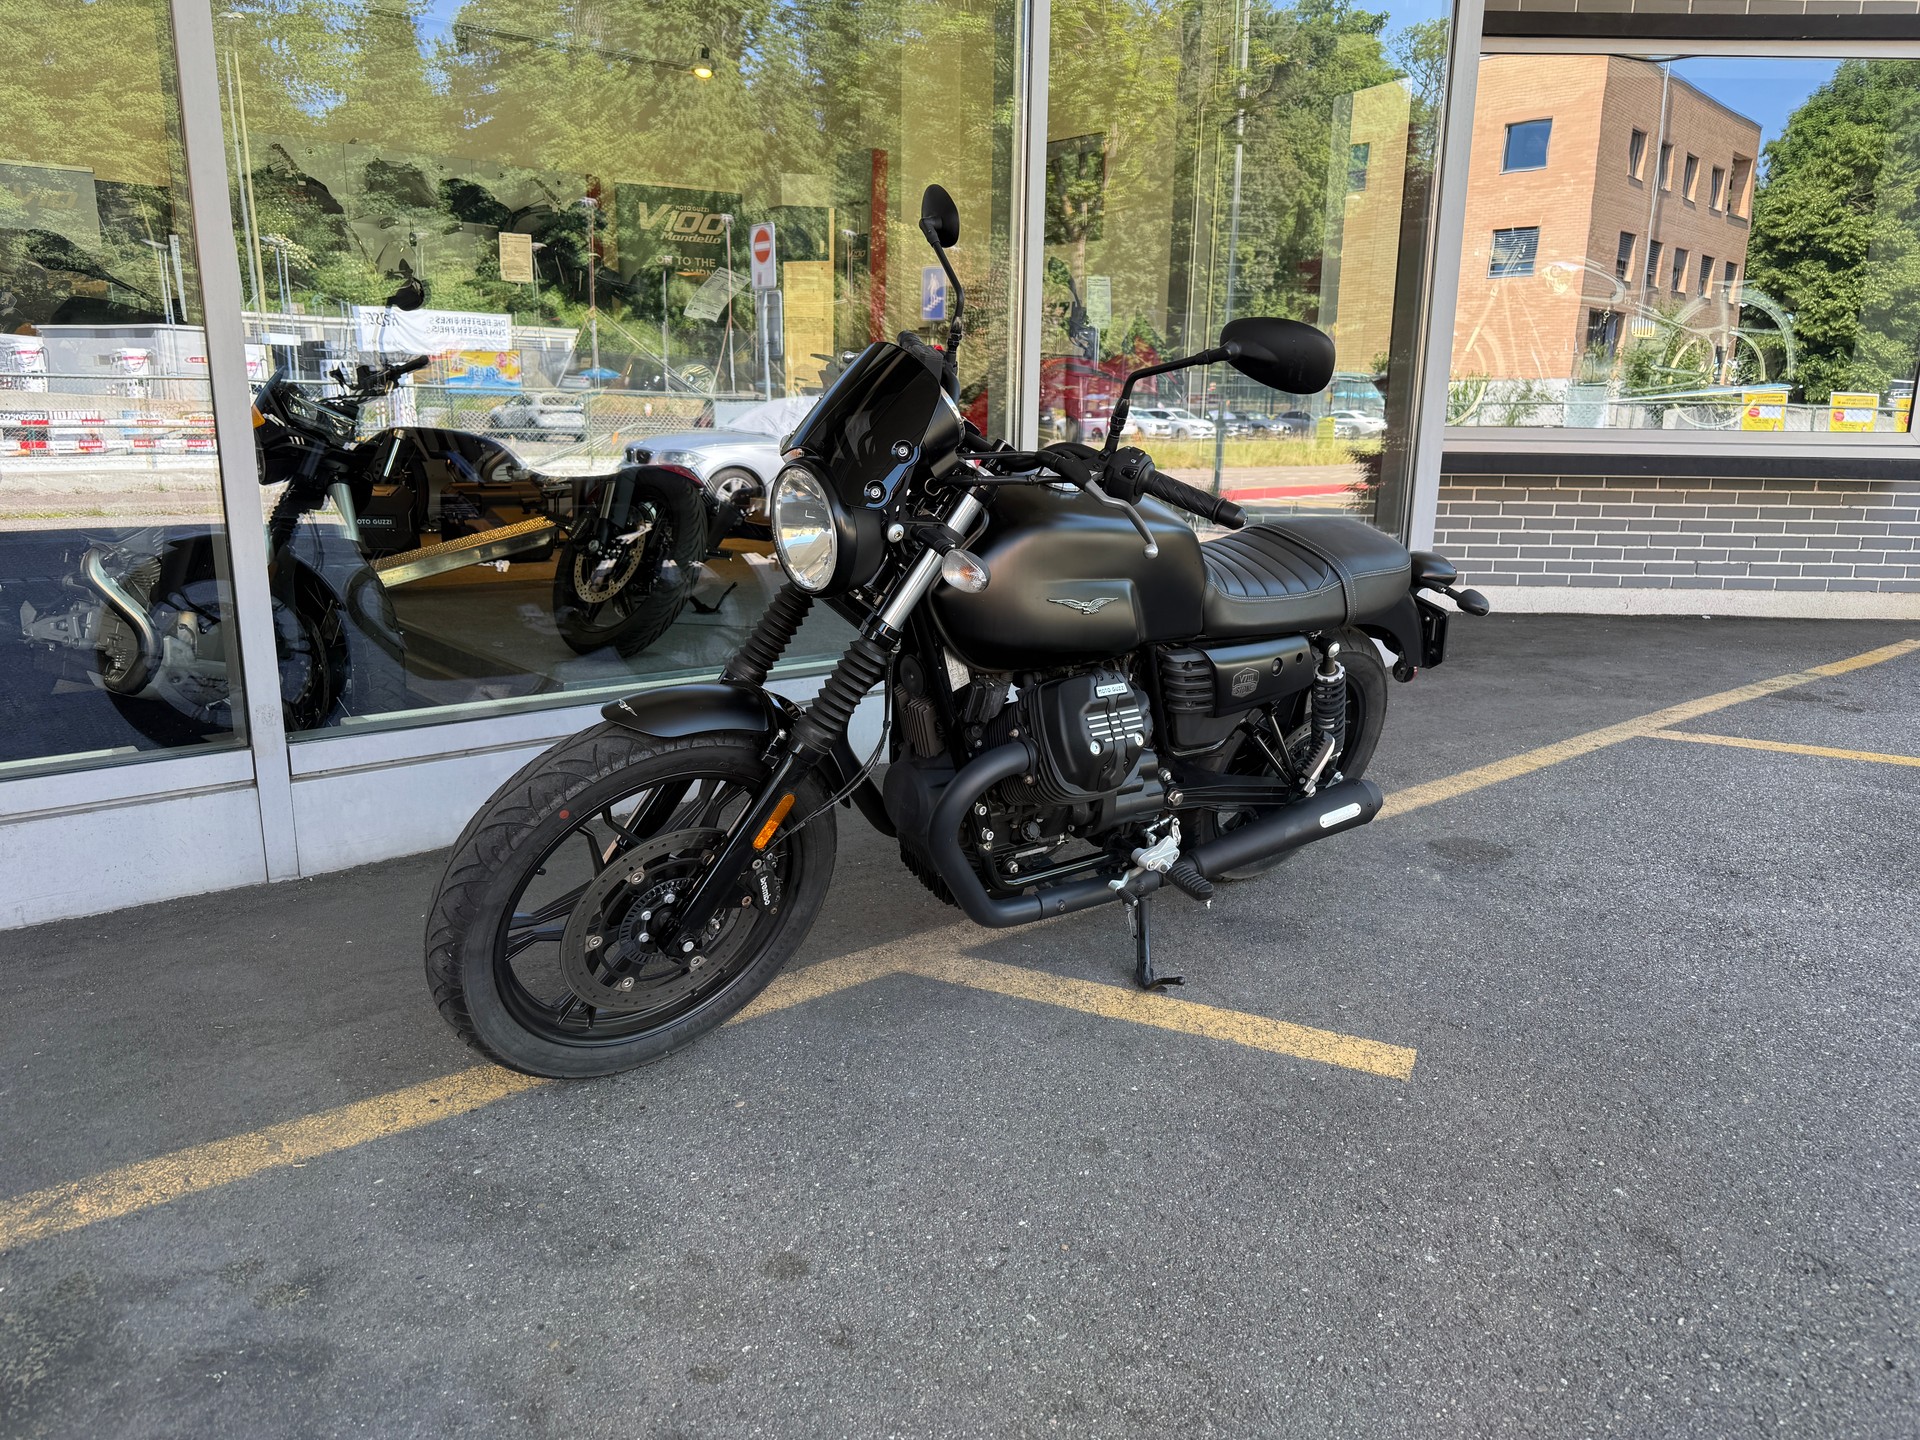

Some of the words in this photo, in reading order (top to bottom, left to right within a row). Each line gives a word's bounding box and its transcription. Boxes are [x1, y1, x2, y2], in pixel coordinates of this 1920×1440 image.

[675, 204, 692, 212] MOTO
[692, 205, 710, 213] GUZZI
[638, 201, 726, 236] V100
[660, 231, 722, 244] Mandello
[675, 255, 692, 266] TO
[694, 257, 716, 269] THE
[760, 875, 772, 906] brembo
